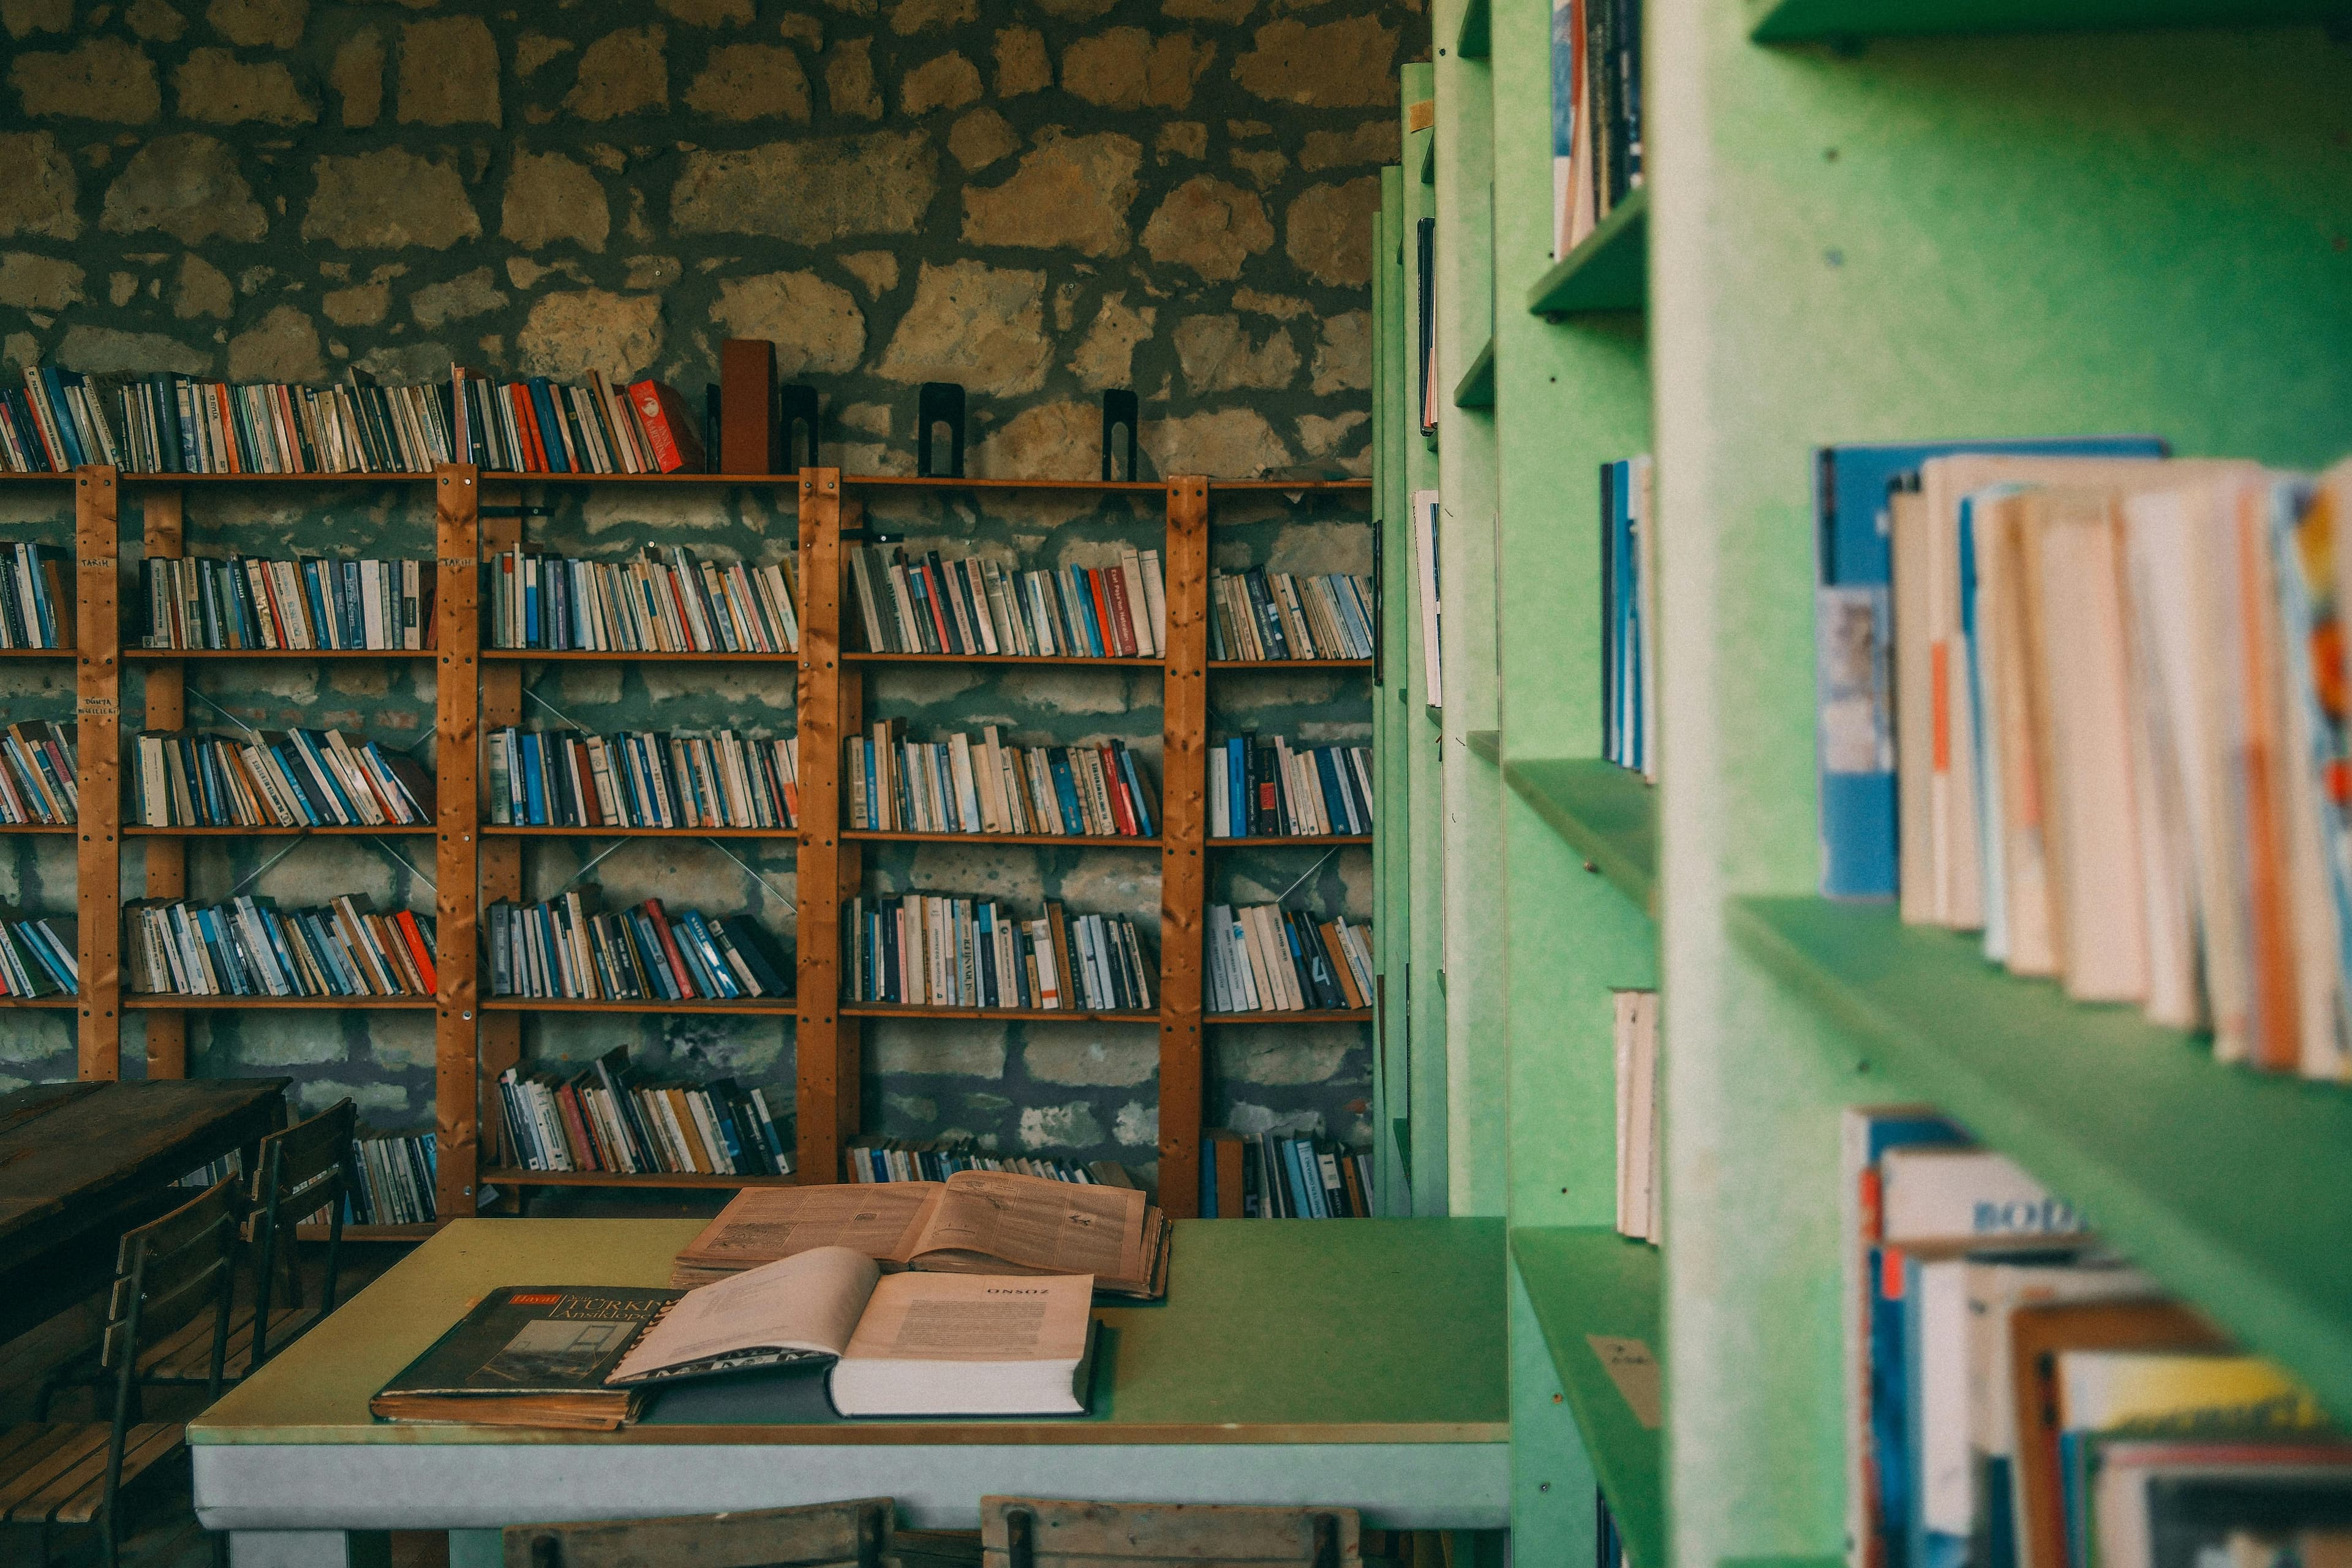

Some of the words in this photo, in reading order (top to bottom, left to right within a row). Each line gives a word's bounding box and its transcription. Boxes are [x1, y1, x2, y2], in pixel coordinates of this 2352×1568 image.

[658, 425, 671, 447] ANNA
[81, 558, 110, 567] TARİH
[516, 1294, 558, 1304] Hayat
